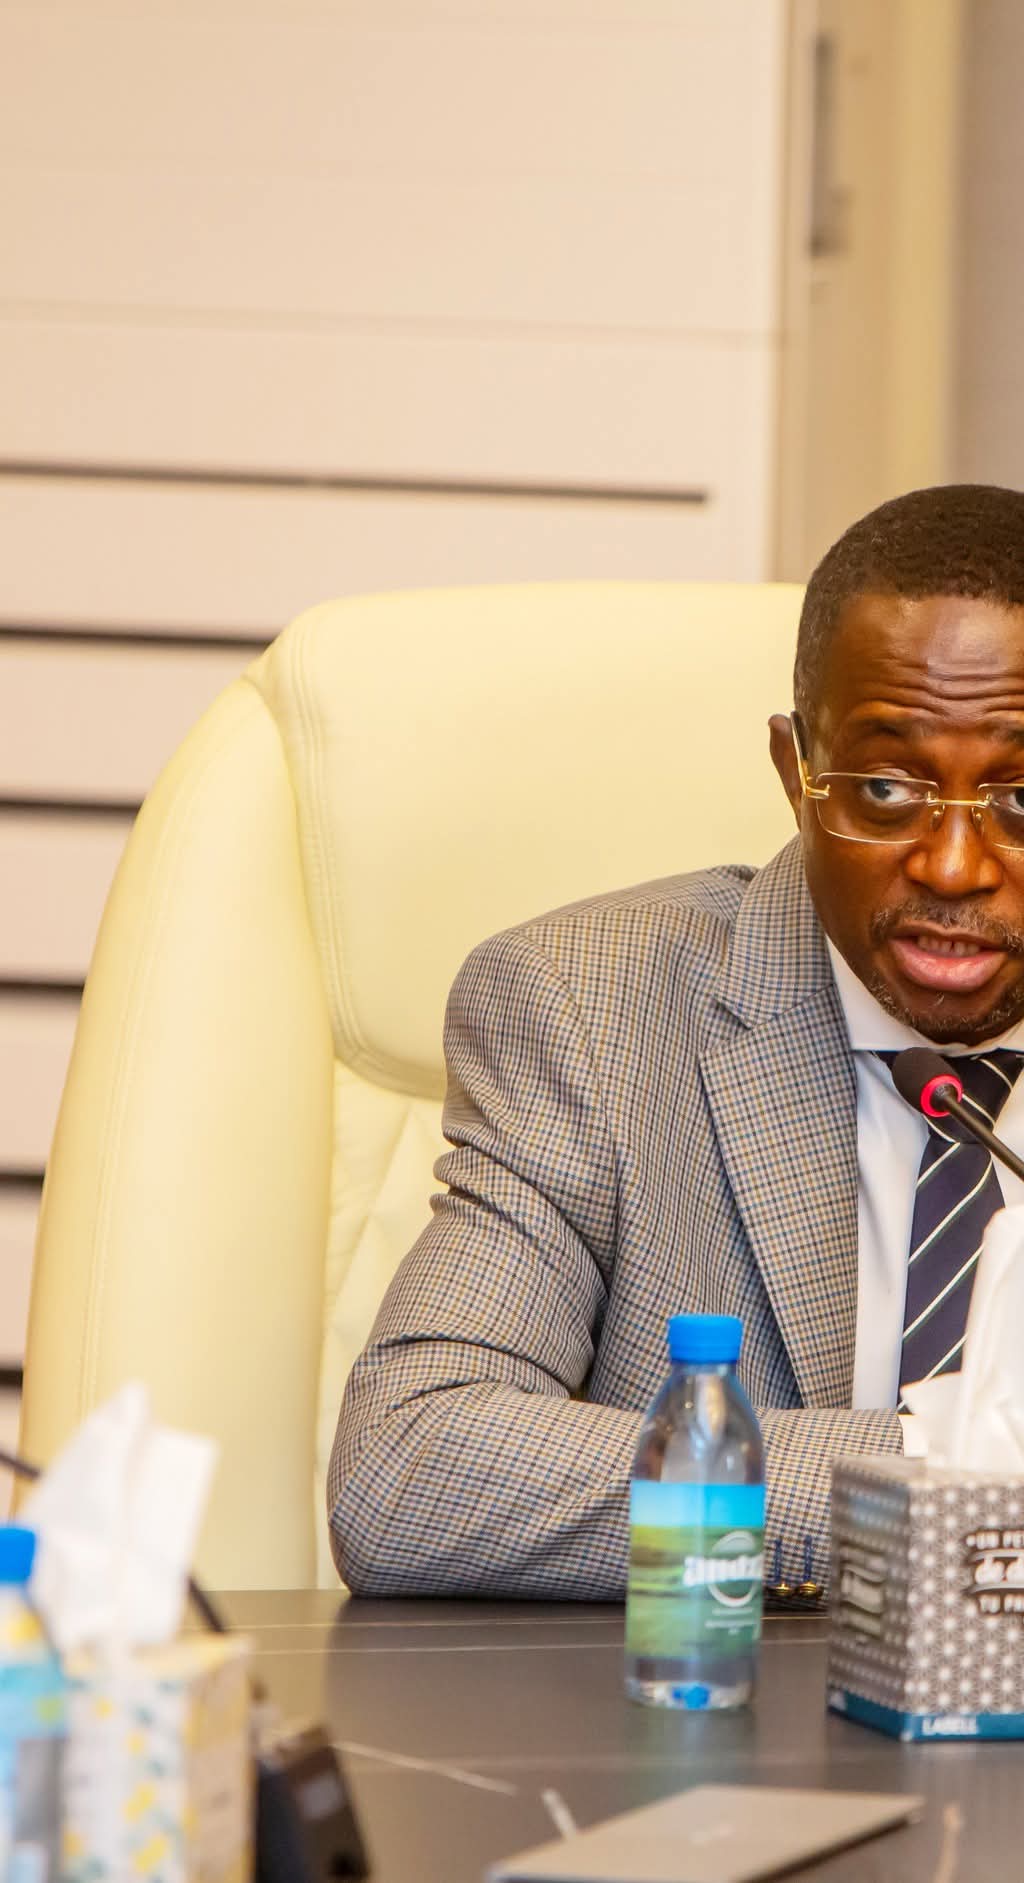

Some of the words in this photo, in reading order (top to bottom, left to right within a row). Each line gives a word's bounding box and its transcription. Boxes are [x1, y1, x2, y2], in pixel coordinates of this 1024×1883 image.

[976, 1530, 999, 1549] UN
[974, 1554, 1005, 1584] de
[980, 1594, 1000, 1613] TU
